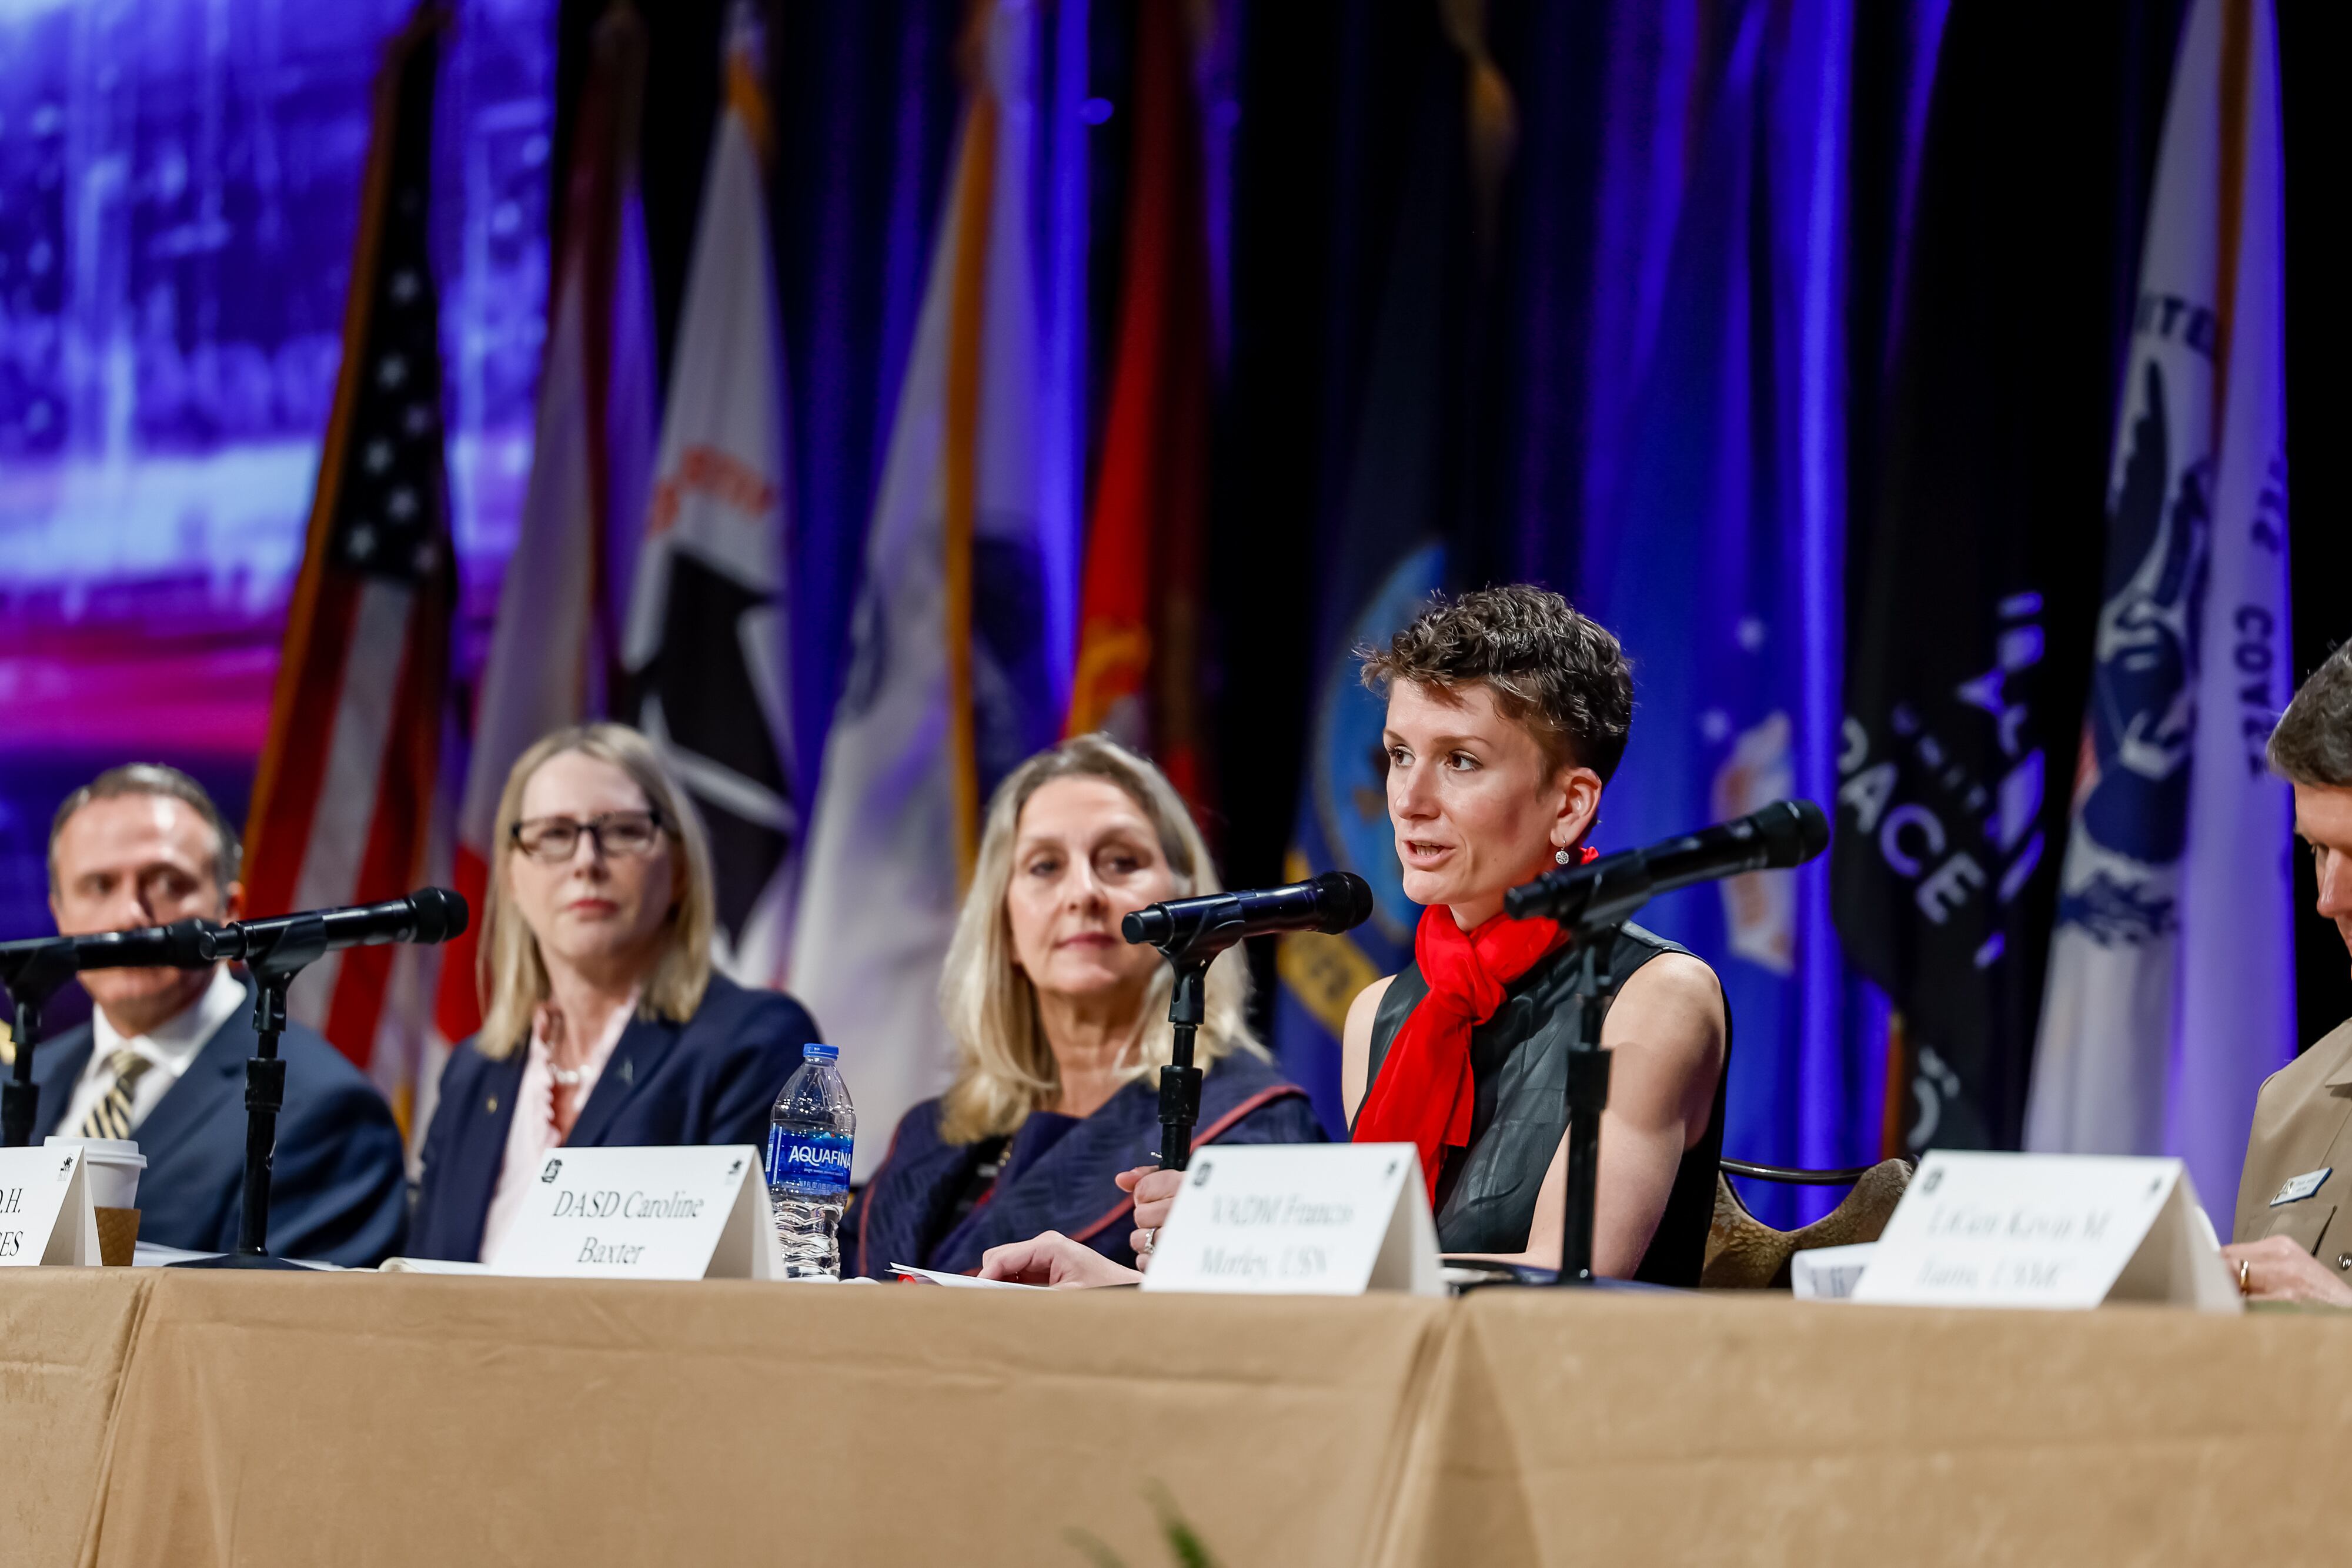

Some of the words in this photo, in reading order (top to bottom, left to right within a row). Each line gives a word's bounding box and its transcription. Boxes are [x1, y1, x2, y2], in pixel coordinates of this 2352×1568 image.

[788, 1145, 851, 1171] AQUAFINA
[552, 1191, 620, 1218] DASD
[624, 1190, 704, 1218] Caroline
[0, 1231, 24, 1256] ES
[577, 1236, 646, 1264] Baxter
